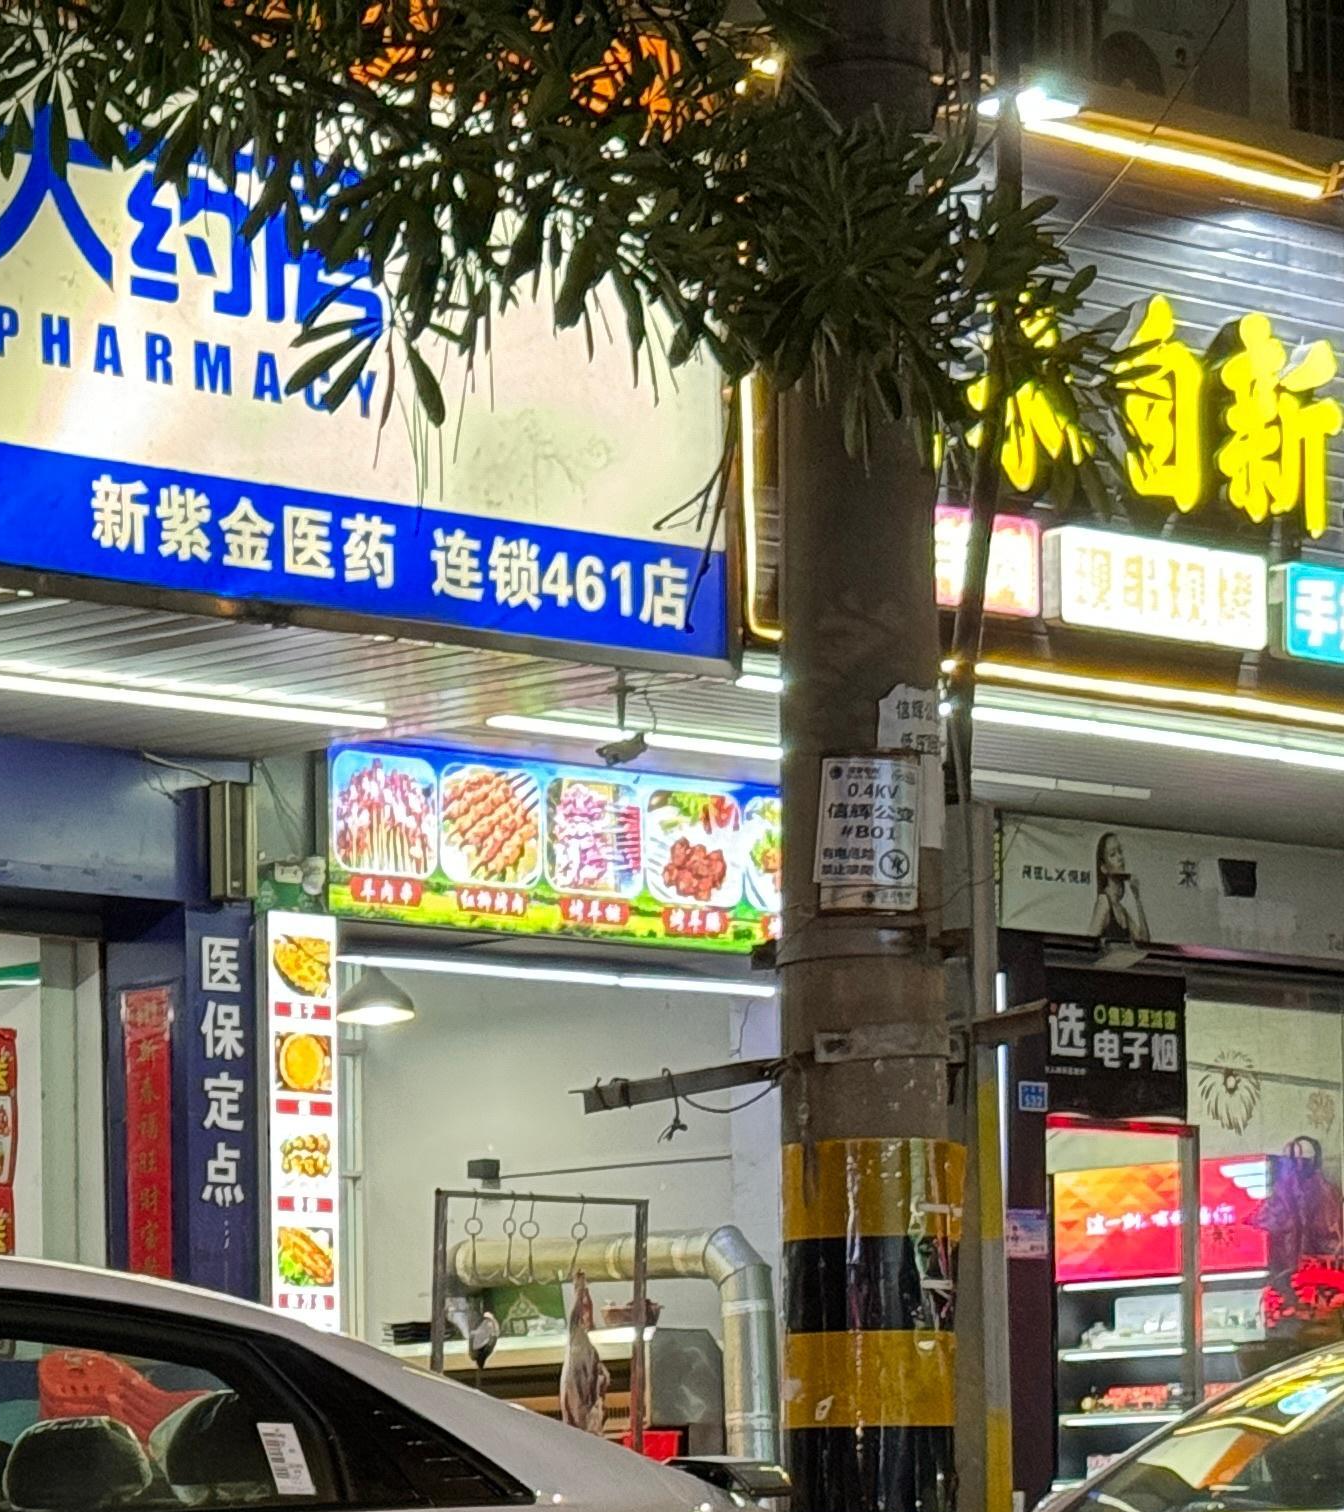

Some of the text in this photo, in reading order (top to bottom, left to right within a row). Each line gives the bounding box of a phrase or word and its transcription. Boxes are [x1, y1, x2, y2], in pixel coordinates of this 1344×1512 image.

[91, 474, 689, 629] 新紫金医药 连锁461店
[847, 784, 900, 799] 0.4KV
[841, 826, 896, 840] #B01
[1049, 1002, 1087, 1058] 选
[1093, 1030, 1178, 1073] 电子烟
[201, 937, 245, 1207] 医保定点
